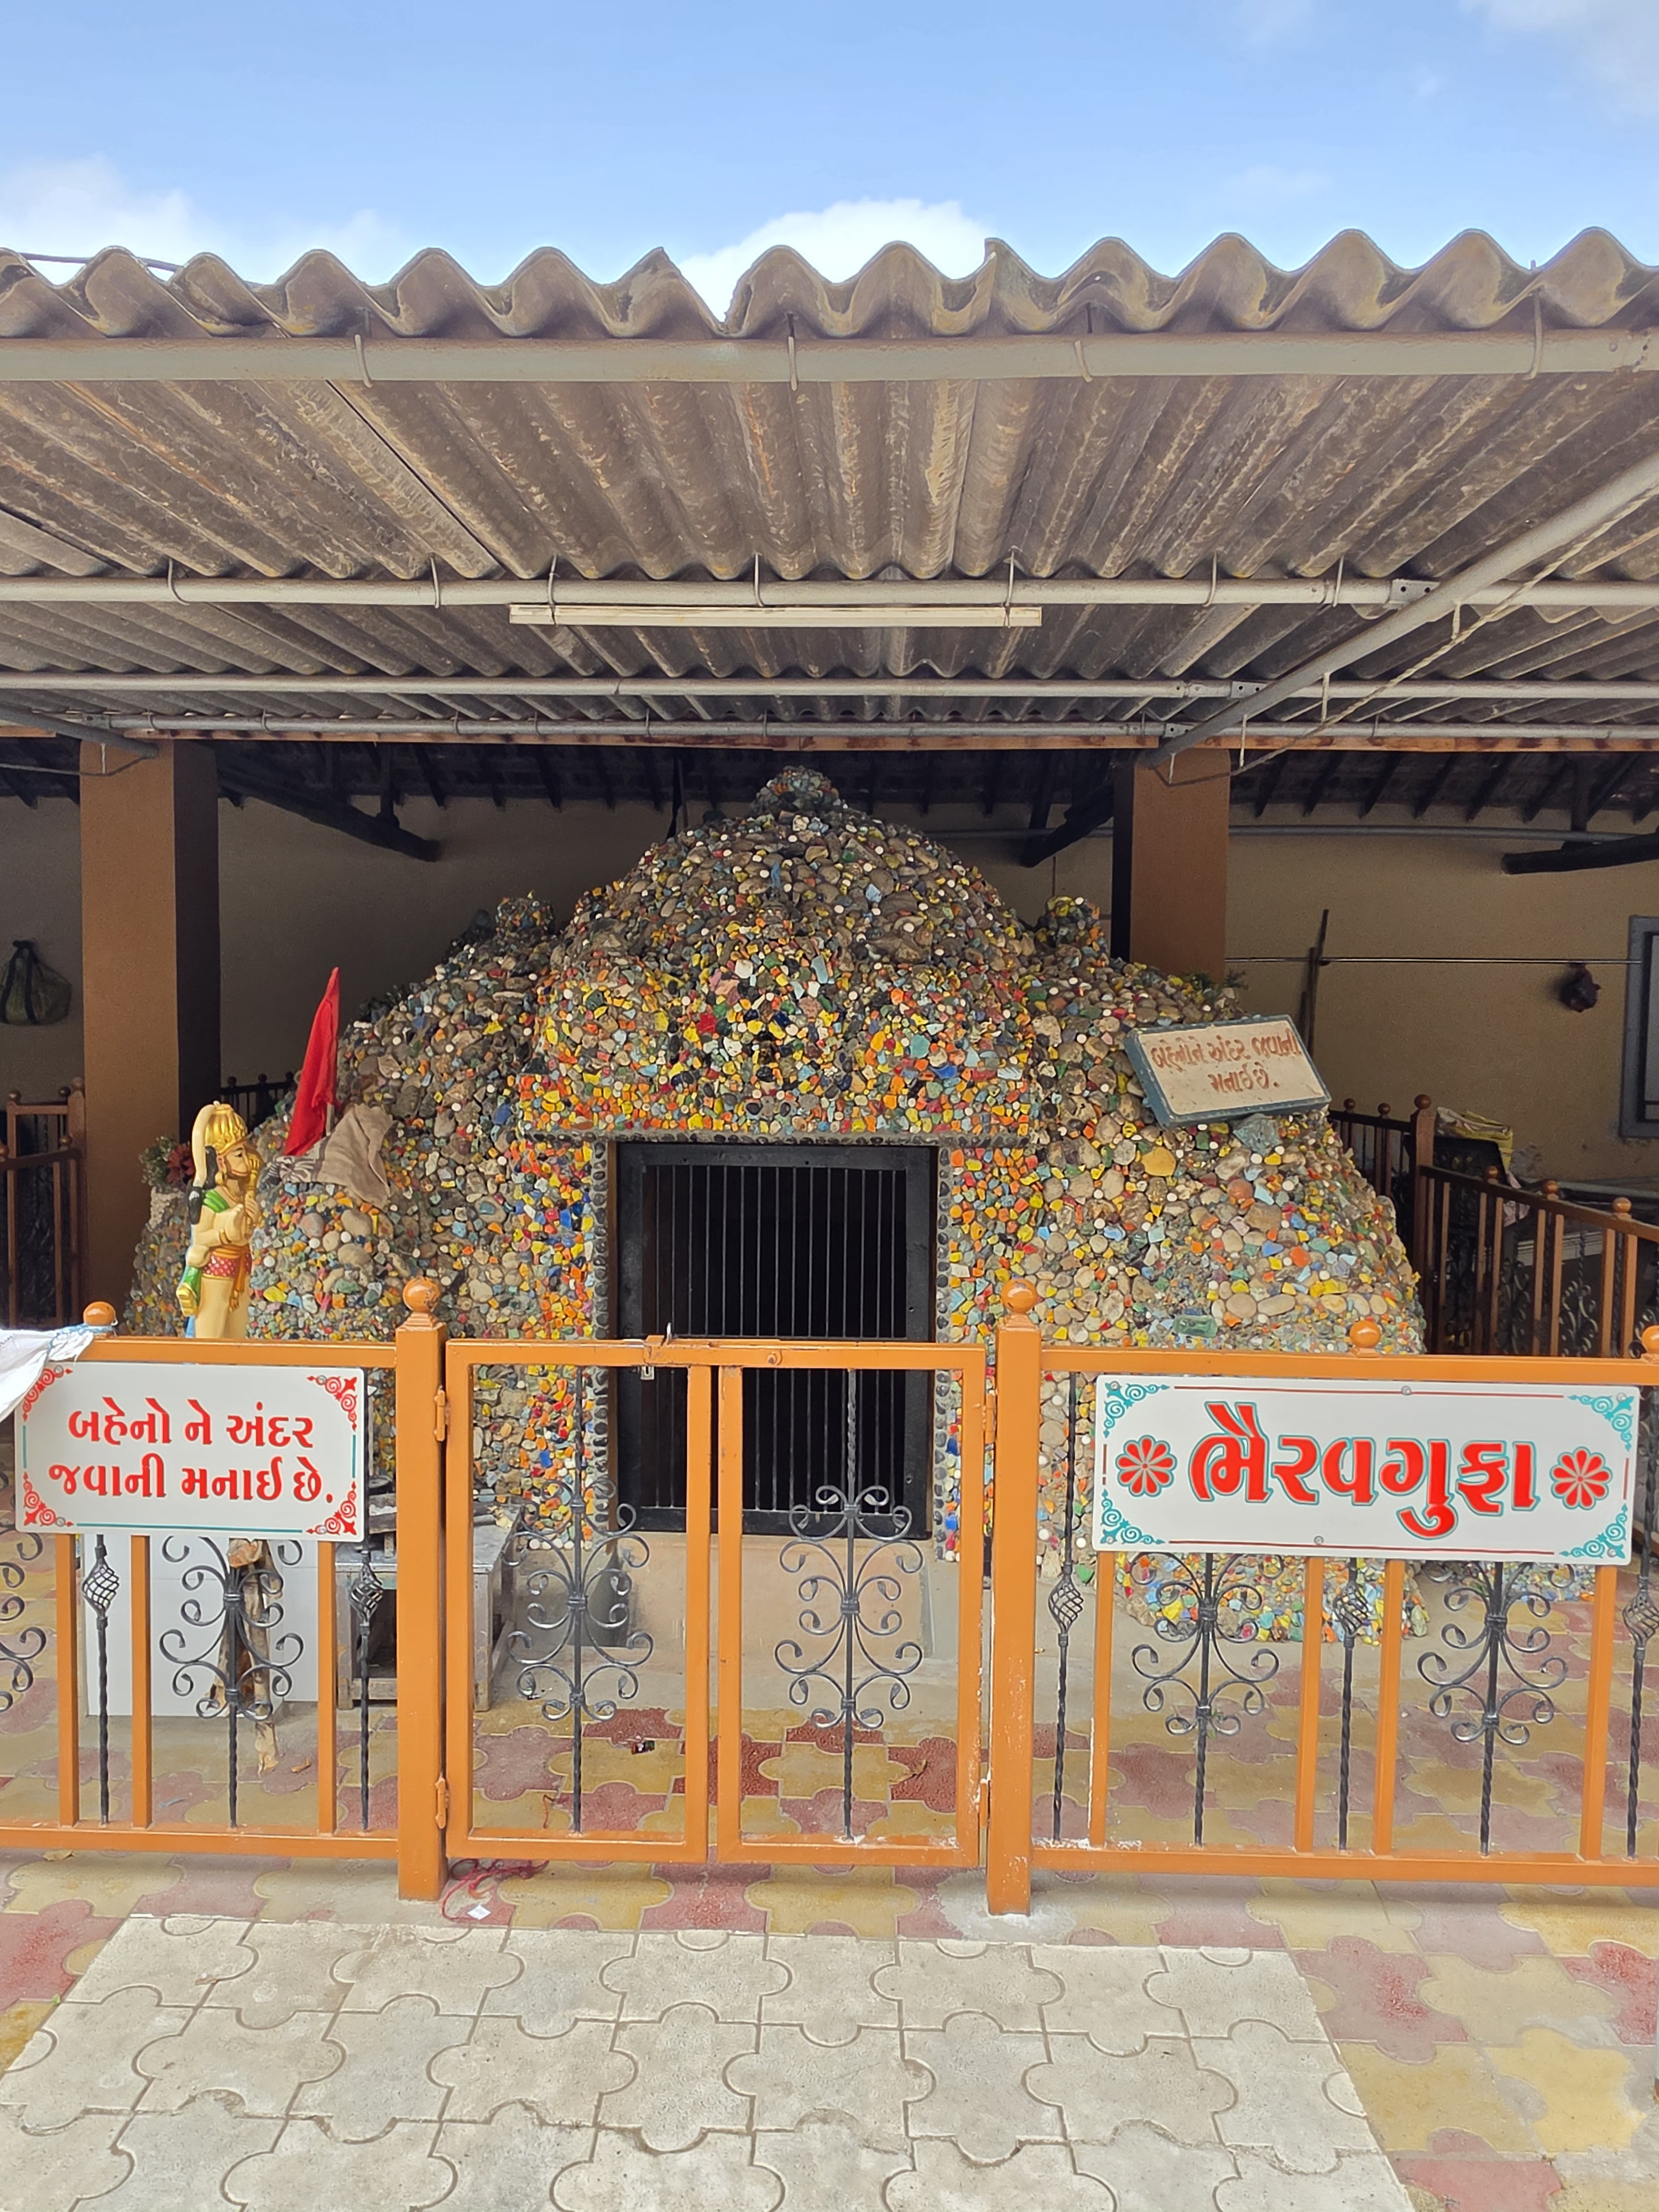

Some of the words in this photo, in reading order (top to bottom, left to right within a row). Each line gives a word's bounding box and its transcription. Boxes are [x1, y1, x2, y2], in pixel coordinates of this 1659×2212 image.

[1206, 1035, 1251, 1062] અંદર
[1251, 1028, 1302, 1058] જવાની
[67, 1397, 171, 1446] બહેનો
[184, 1399, 212, 1445] ને
[226, 1401, 314, 1448] અંદર
[49, 1453, 166, 1498] જવાની
[180, 1456, 283, 1500] મનાઈ
[293, 1457, 333, 1503] છે.
[1188, 1401, 1541, 1539] ભૈરવગુફા
